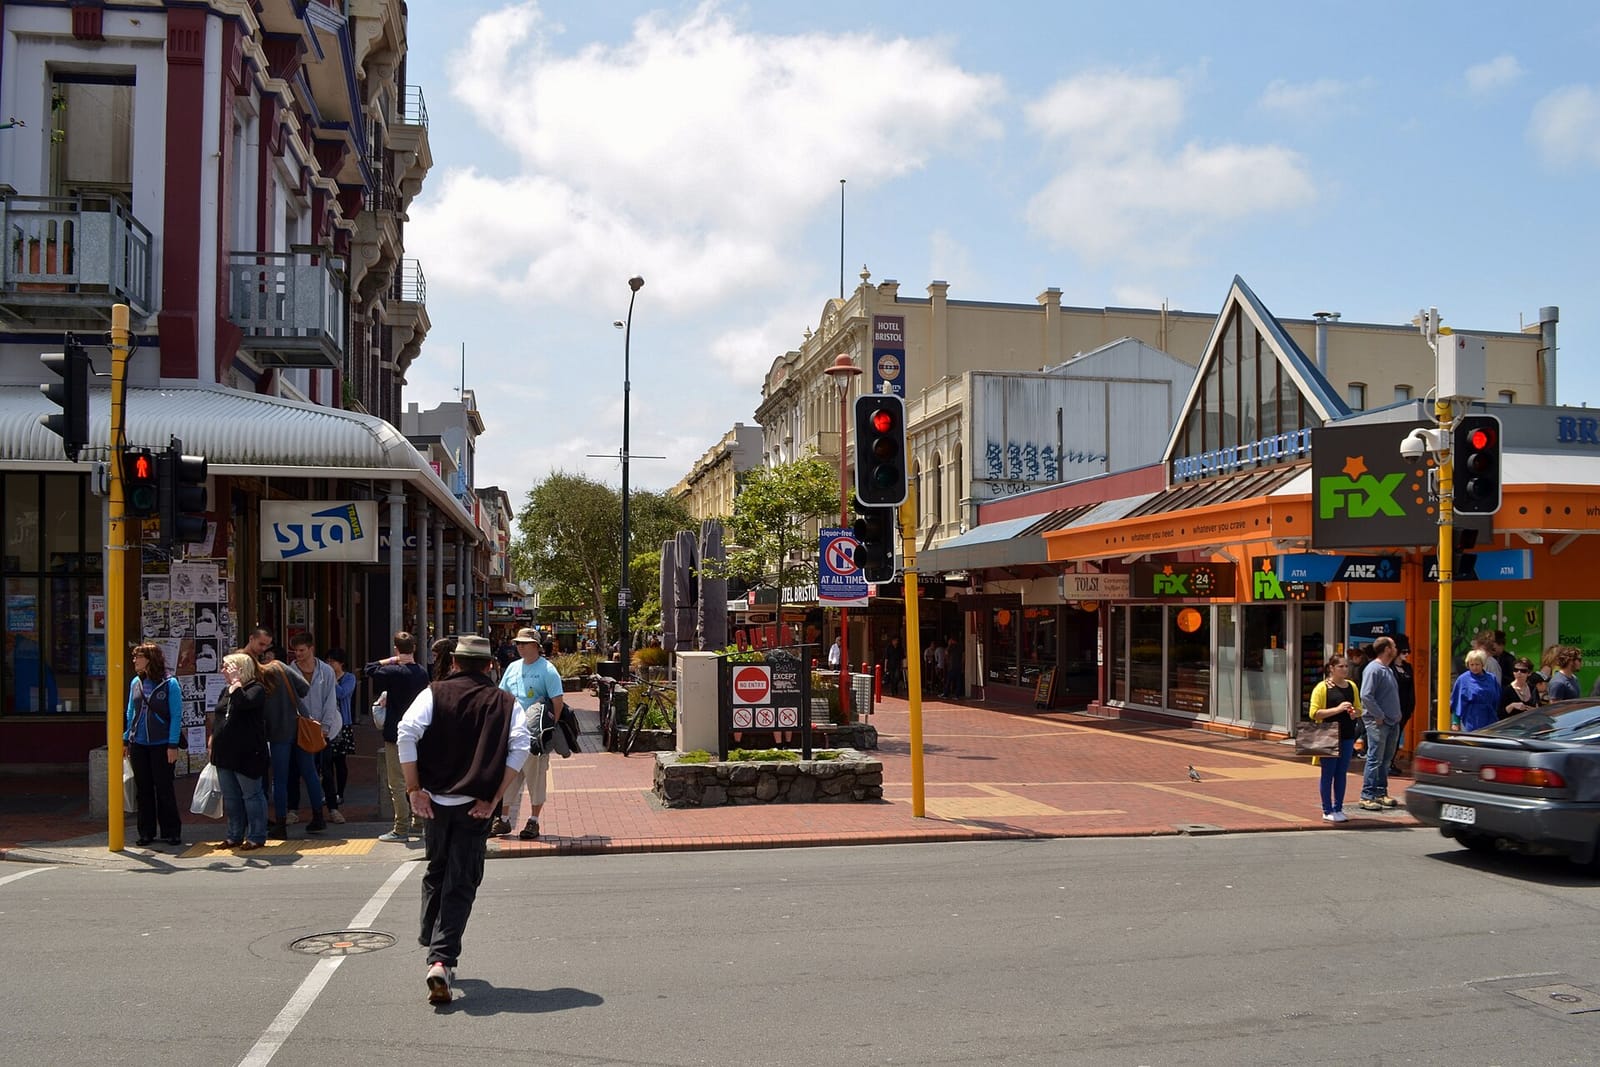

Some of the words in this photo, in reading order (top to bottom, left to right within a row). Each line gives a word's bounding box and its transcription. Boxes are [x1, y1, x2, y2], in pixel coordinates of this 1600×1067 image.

[878, 322, 900, 331] HOTEL
[875, 333, 903, 342] BRISTOL
[347, 504, 360, 538] TRAVEL
[1193, 523, 1217, 534] whatever
[1218, 522, 1229, 535] you
[1230, 520, 1246, 530] crave
[821, 529, 853, 538] Liquor-free
[1131, 532, 1151, 542] whatever
[1152, 530, 1161, 541] you
[1162, 528, 1175, 538] need
[1291, 569, 1307, 577] ATM
[1344, 564, 1377, 578] ANZ
[1500, 566, 1514, 575] ATM
[820, 575, 830, 584] AT
[831, 575, 844, 584] ALL
[1195, 574, 1209, 584] 24
[794, 583, 820, 602] BRISTOL
[1371, 625, 1384, 634] ANZ
[1558, 634, 1581, 645] Food
